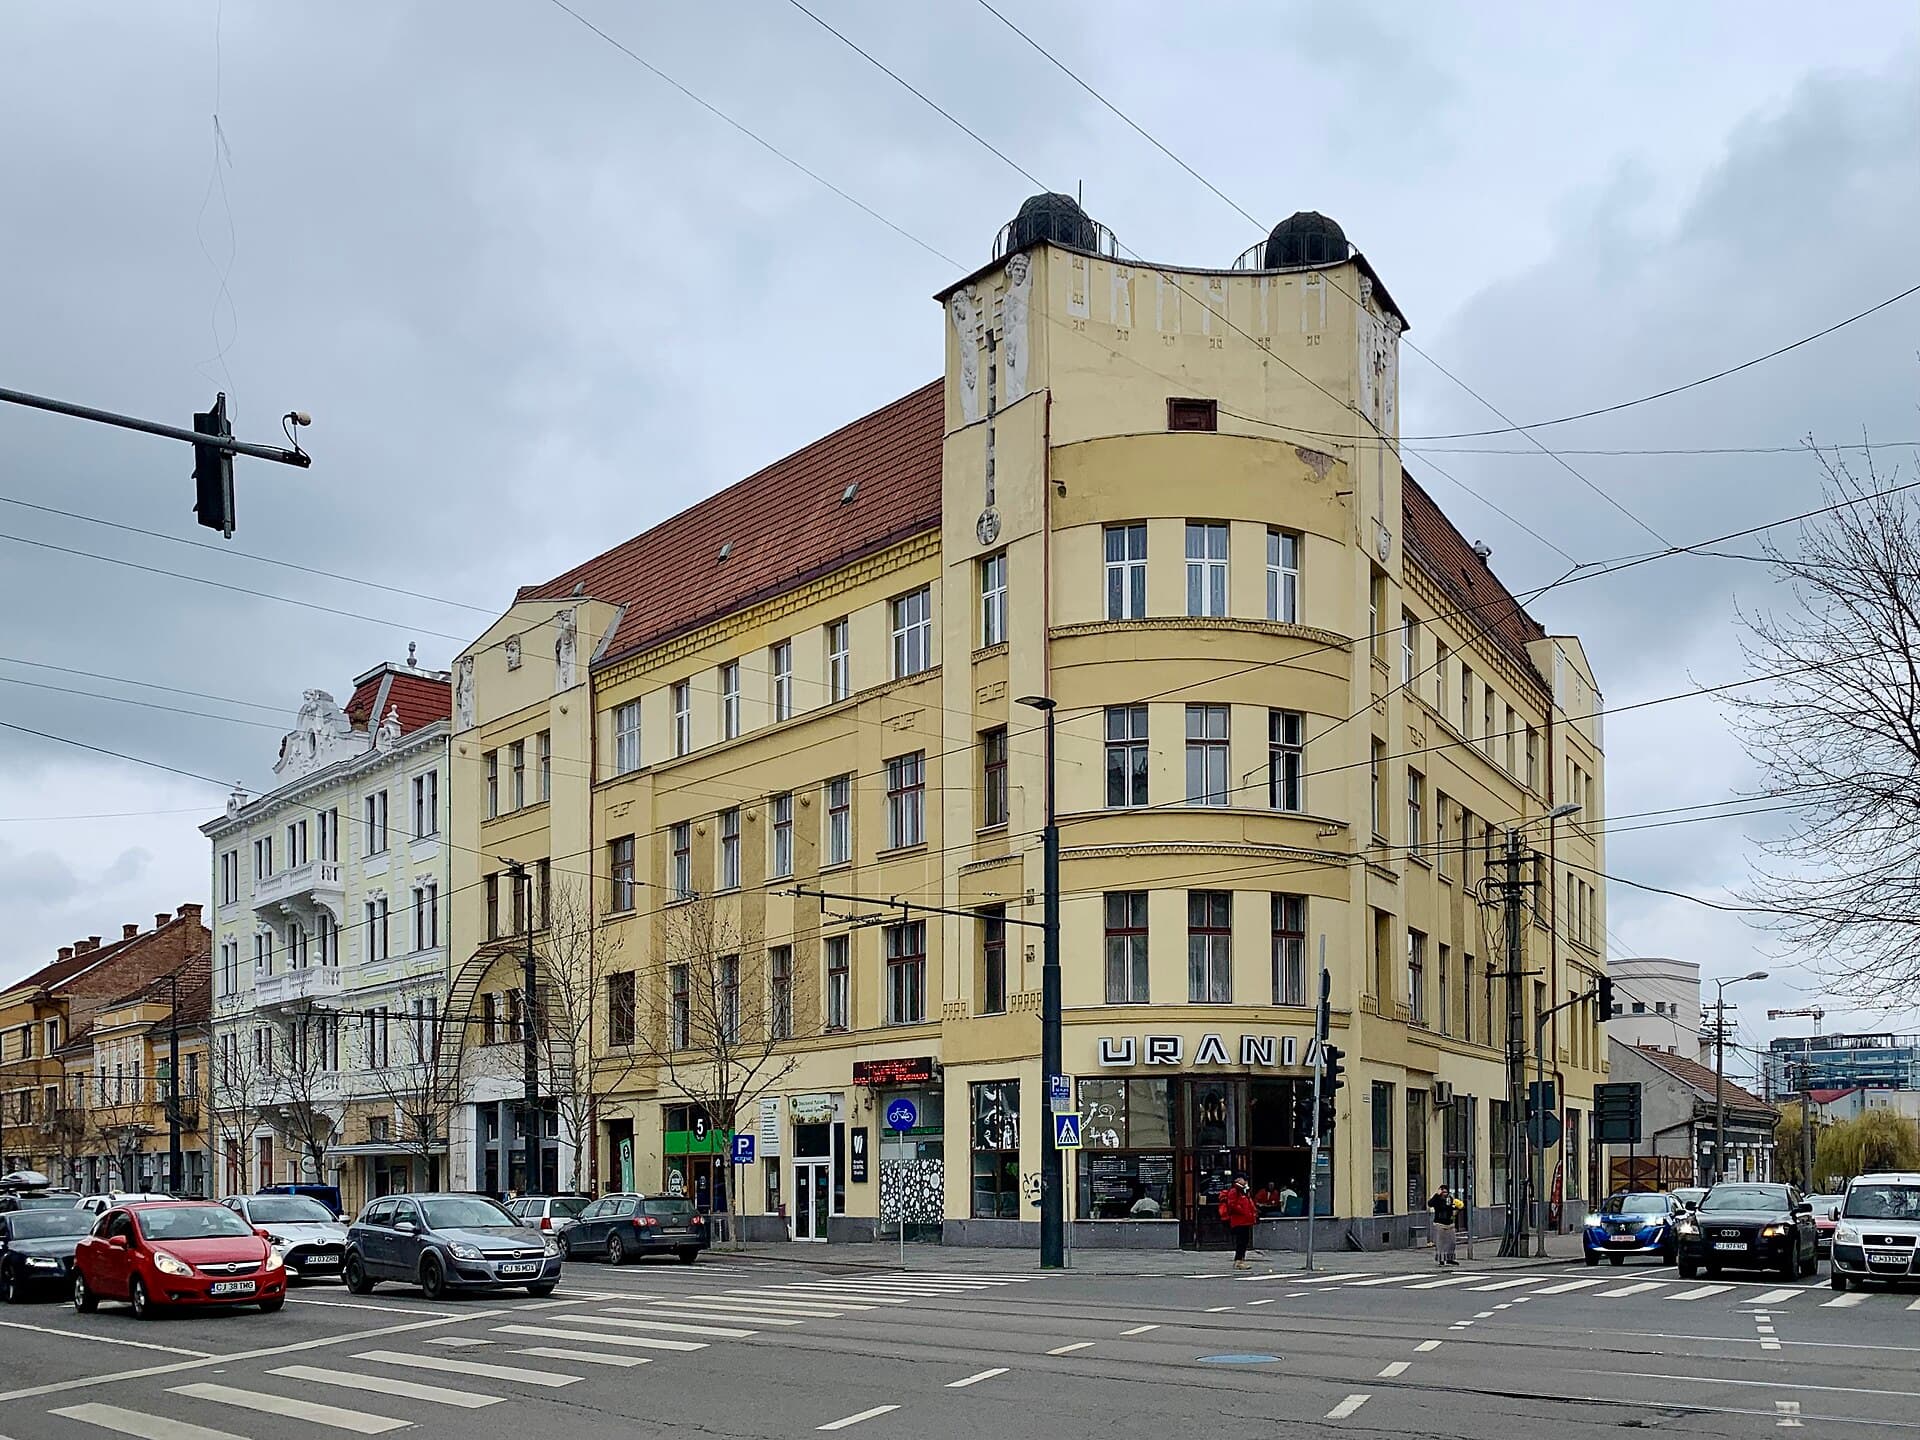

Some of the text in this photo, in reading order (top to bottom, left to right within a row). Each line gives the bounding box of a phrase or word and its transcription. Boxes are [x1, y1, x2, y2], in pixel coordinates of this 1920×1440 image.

[1098, 1034, 1329, 1068] URANIA
[1052, 1076, 1060, 1092] P
[697, 1118, 704, 1135] 5
[738, 1138, 749, 1155] P
[216, 1283, 227, 1291] CJ
[239, 1281, 254, 1290] TMG
